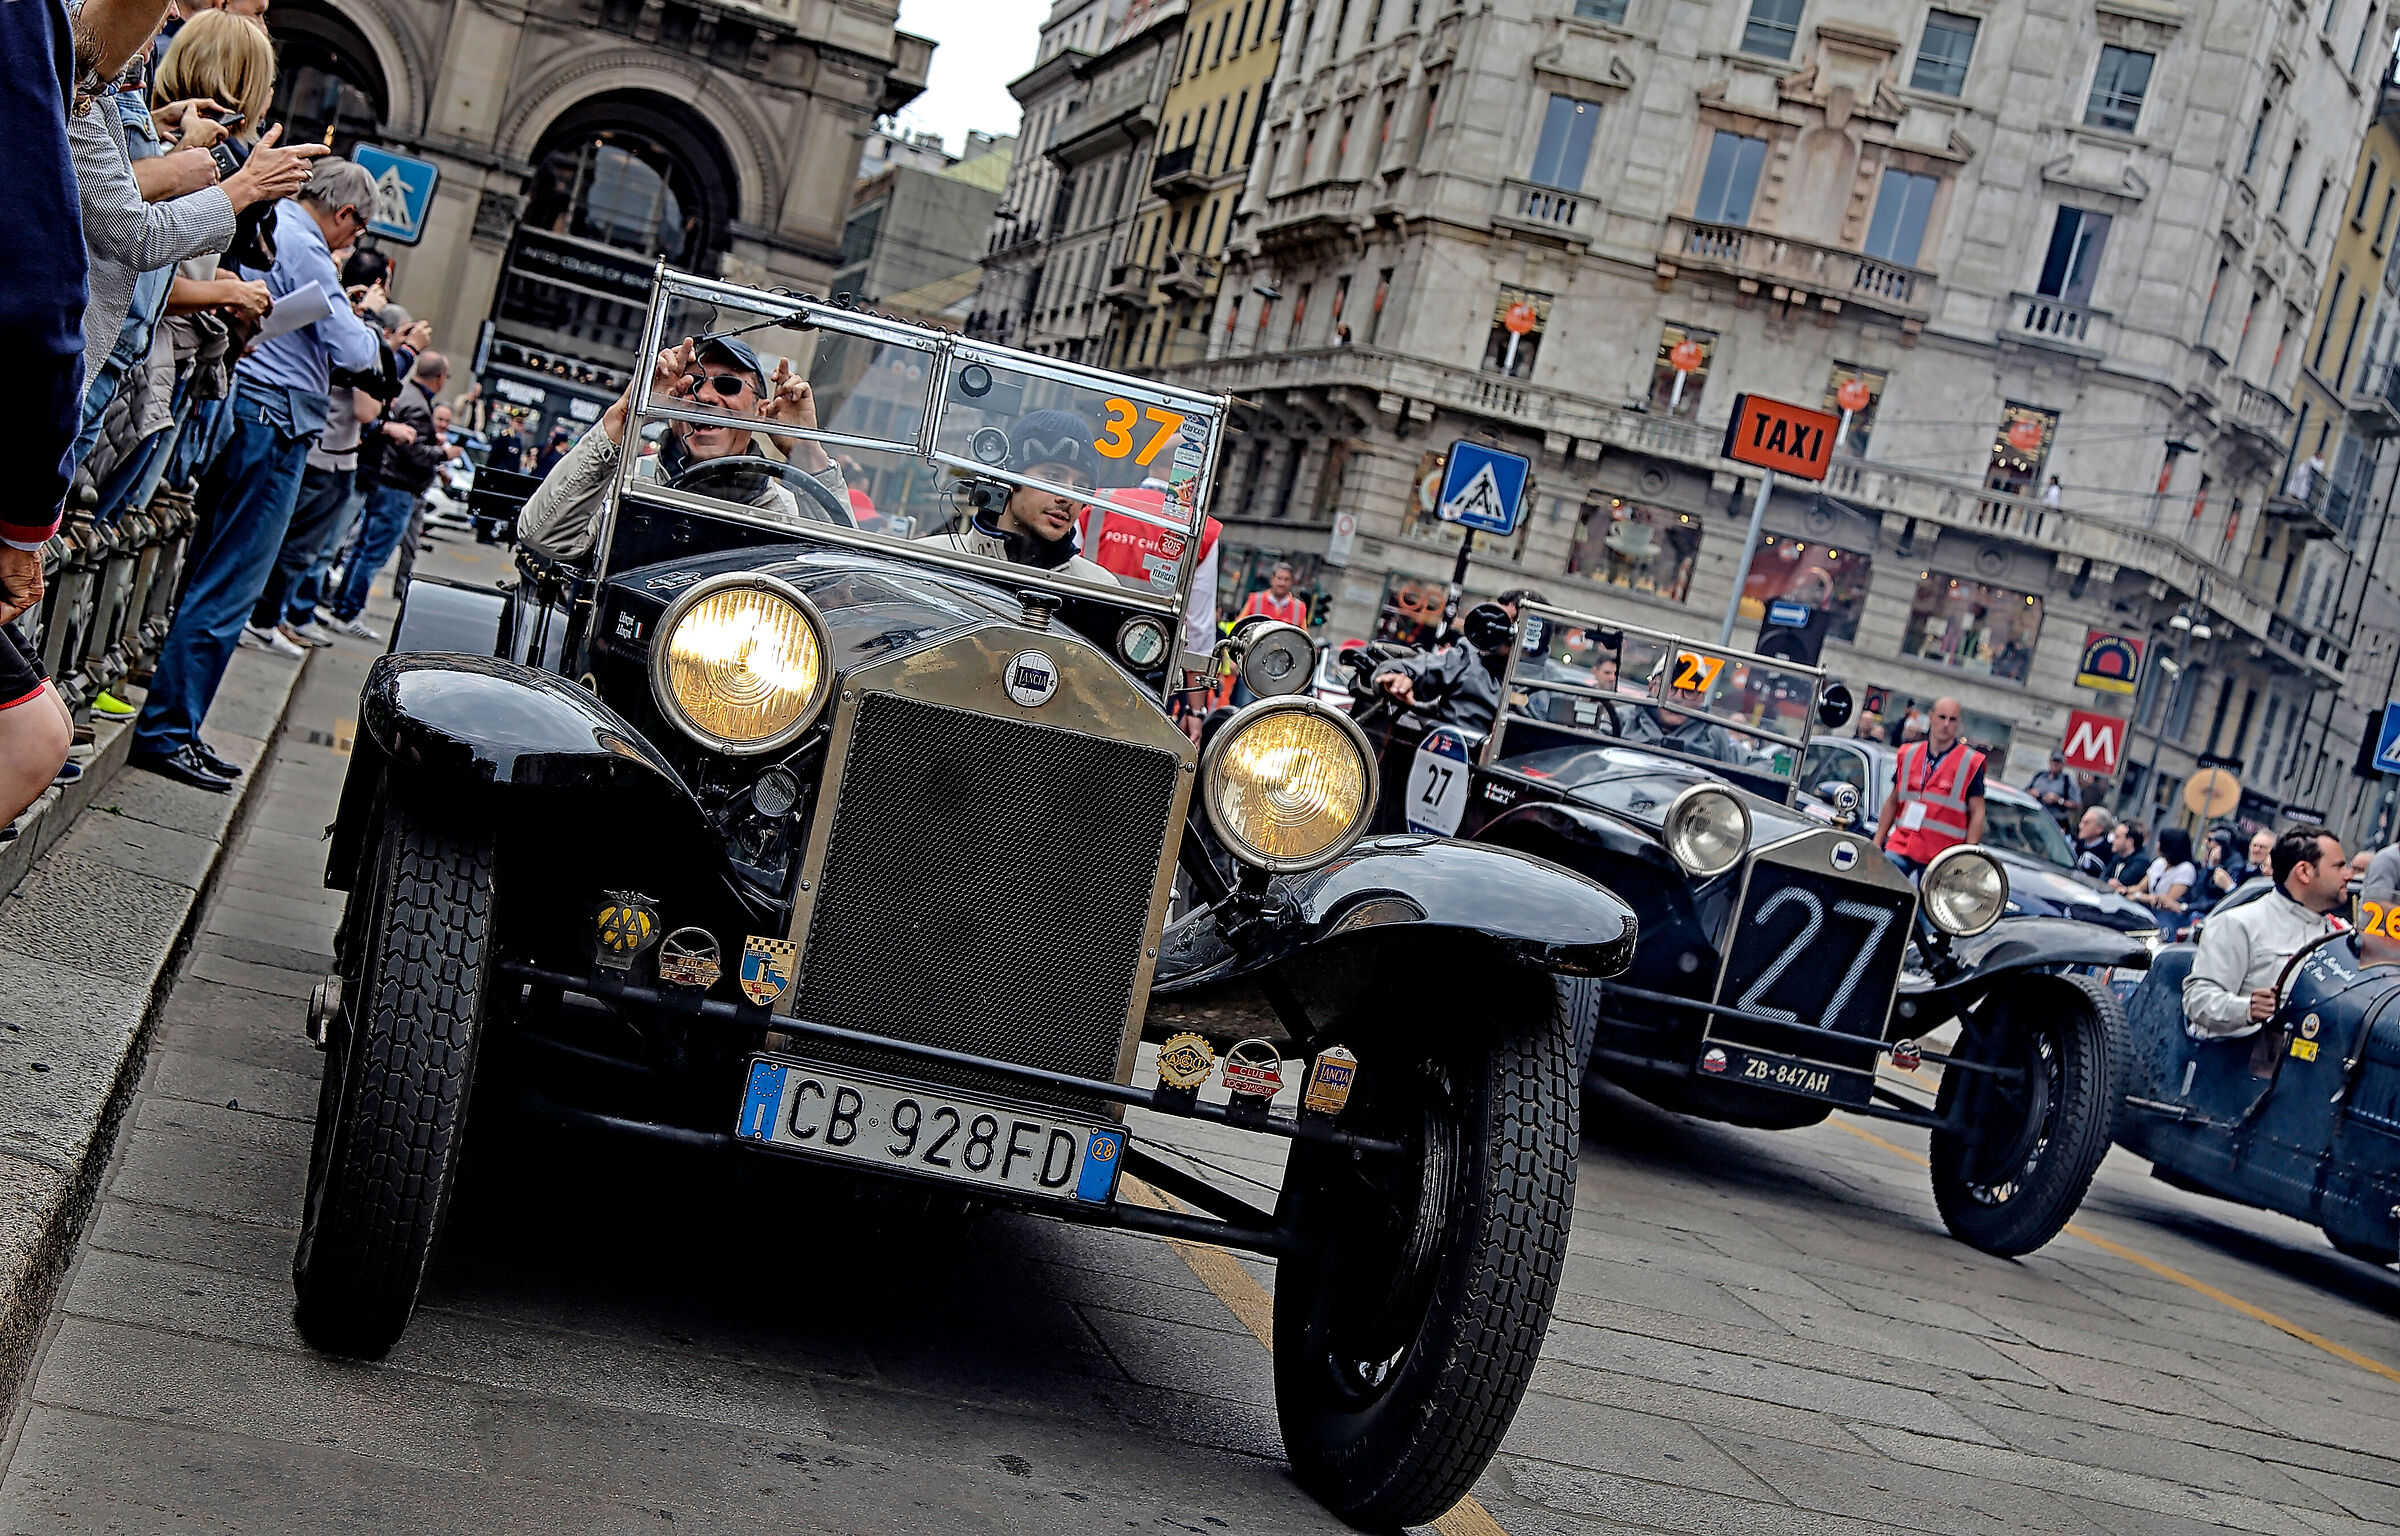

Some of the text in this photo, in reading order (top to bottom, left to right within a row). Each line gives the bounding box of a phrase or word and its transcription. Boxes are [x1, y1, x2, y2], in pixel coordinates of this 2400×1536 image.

[1093, 398, 1185, 467] 37
[1753, 412, 1825, 464] TAXI
[1104, 531, 1137, 545] POST
[1162, 538, 1182, 552] 2015
[1018, 668, 1048, 687] LANCIA
[1673, 652, 1726, 693] 27
[2064, 721, 2116, 767] M
[1421, 763, 1454, 807] 27
[2361, 901, 2400, 942] 26
[1736, 885, 1895, 1031] 27
[1239, 1067, 1266, 1080] CLUB
[1319, 1064, 1350, 1084] LANCIA
[1744, 1058, 1831, 1094] ZB 847AH
[786, 1078, 1079, 1188] CB 928FD
[1094, 1141, 1114, 1158] 28
